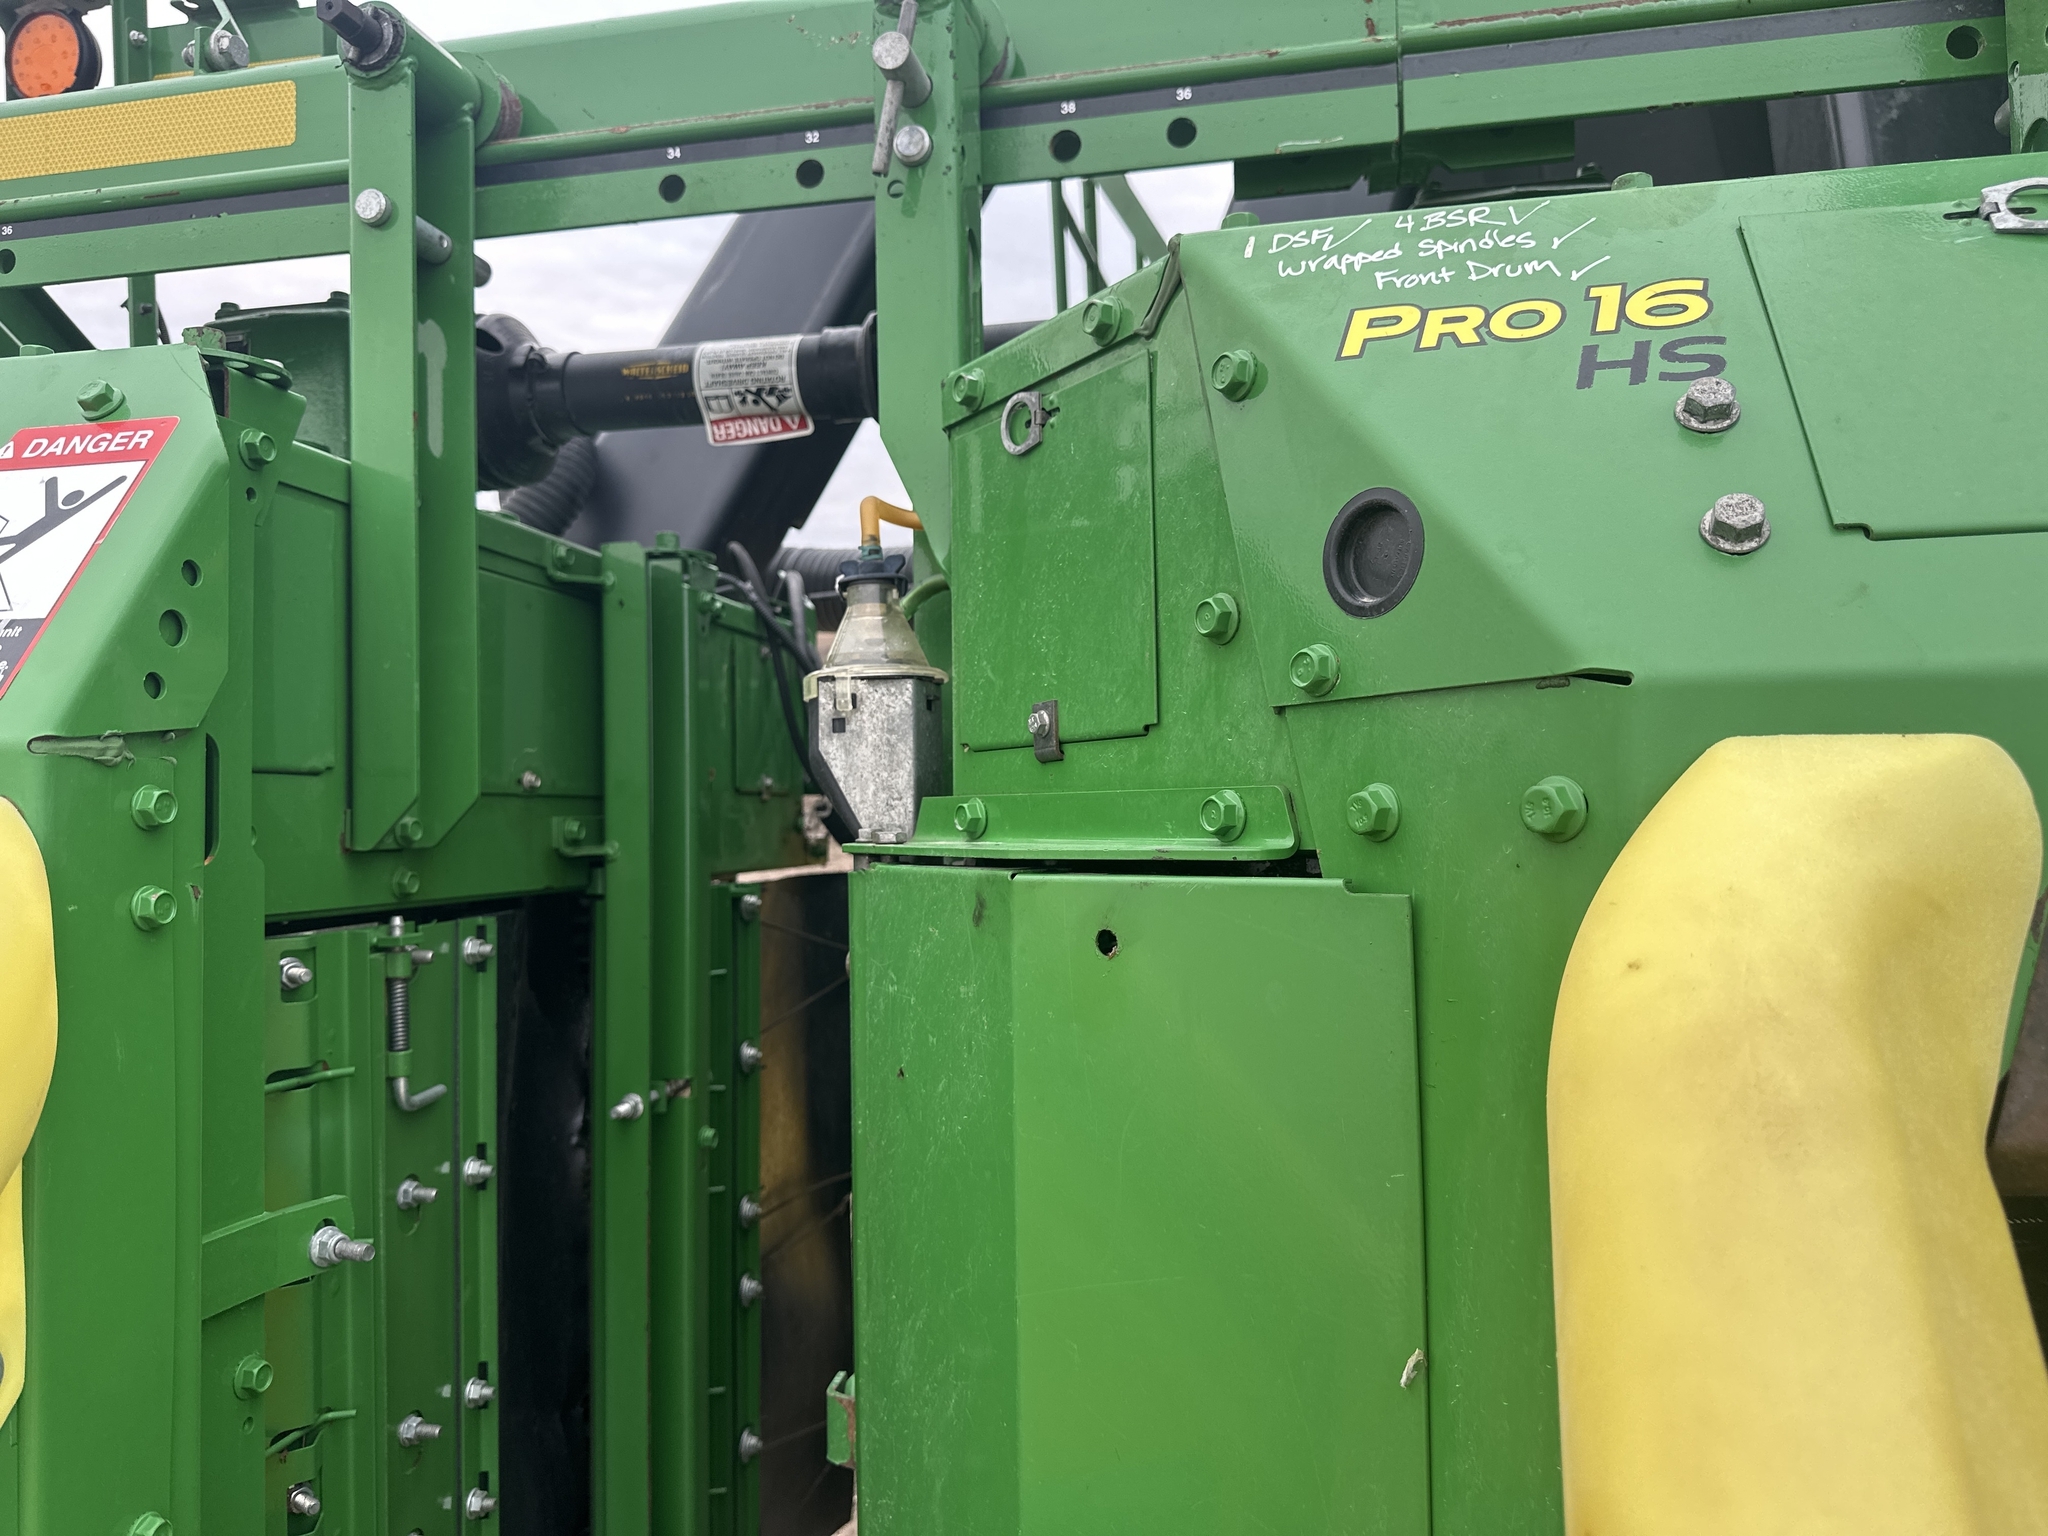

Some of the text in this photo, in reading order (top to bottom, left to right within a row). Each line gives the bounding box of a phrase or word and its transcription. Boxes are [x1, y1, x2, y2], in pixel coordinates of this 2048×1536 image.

[1175, 86, 1193, 101] 36
[1060, 101, 1077, 115] 38
[804, 130, 820, 144] 32
[666, 146, 682, 160] 34
[2, 225, 13, 236] 36
[1394, 214, 1415, 234] 4
[1420, 206, 1507, 232] BSR
[1374, 260, 1562, 291] Front Drum
[1335, 277, 1714, 362] PRO 16
[1576, 336, 1728, 390] HS
[712, 415, 783, 441] DANGER
[21, 429, 154, 459] DANGER
